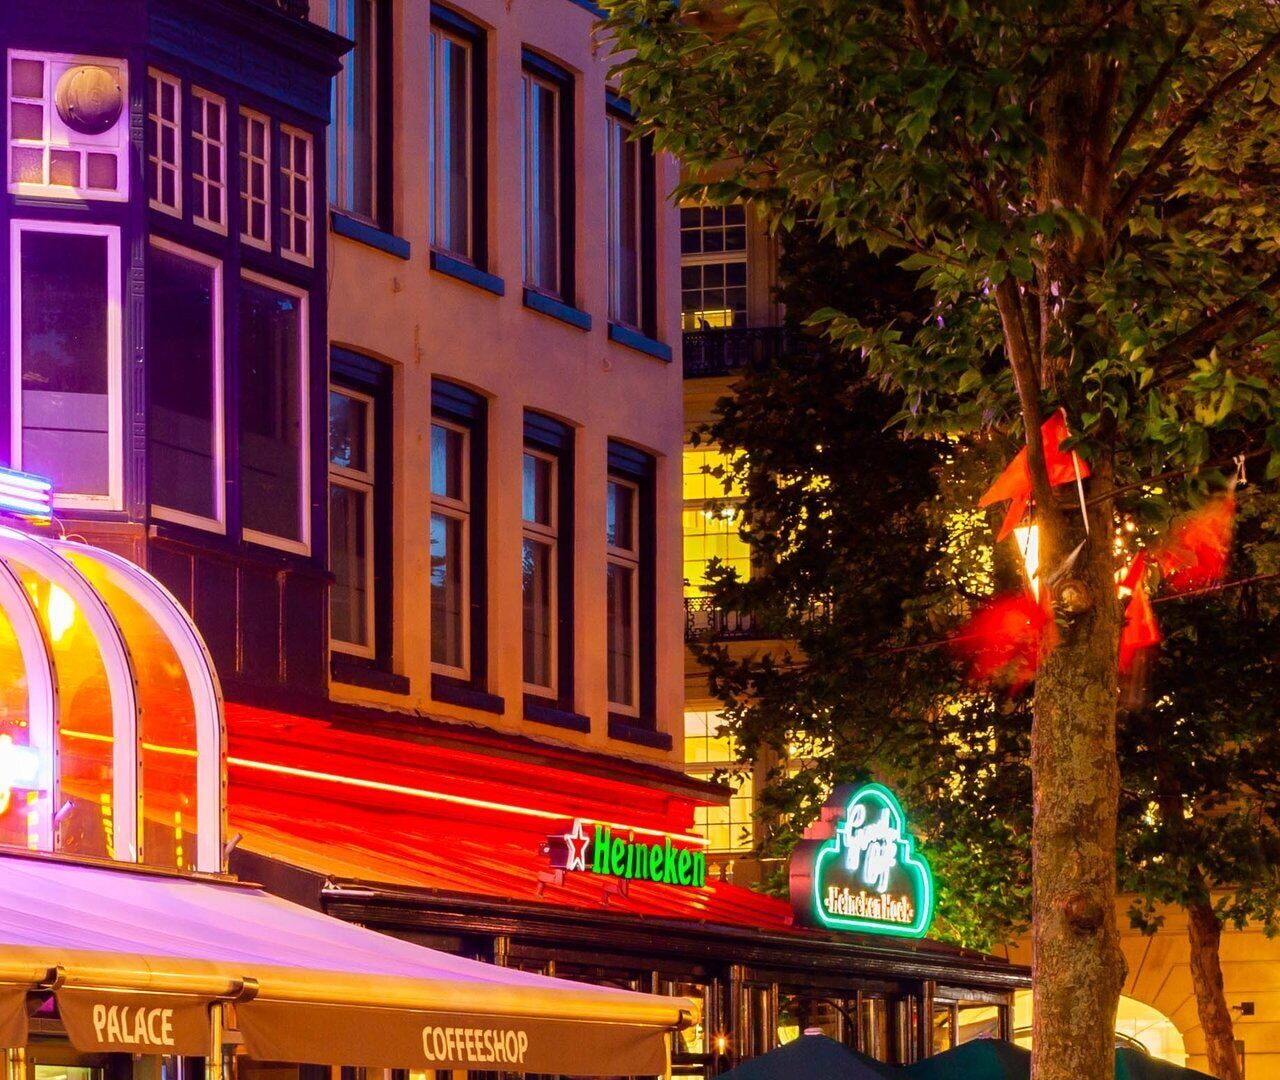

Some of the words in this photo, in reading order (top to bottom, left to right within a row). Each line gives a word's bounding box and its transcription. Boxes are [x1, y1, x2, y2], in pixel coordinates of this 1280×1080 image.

[592, 824, 706, 887] Heineken
[93, 1004, 175, 1046] PALACE
[422, 1026, 528, 1064] COFFEESHOP
